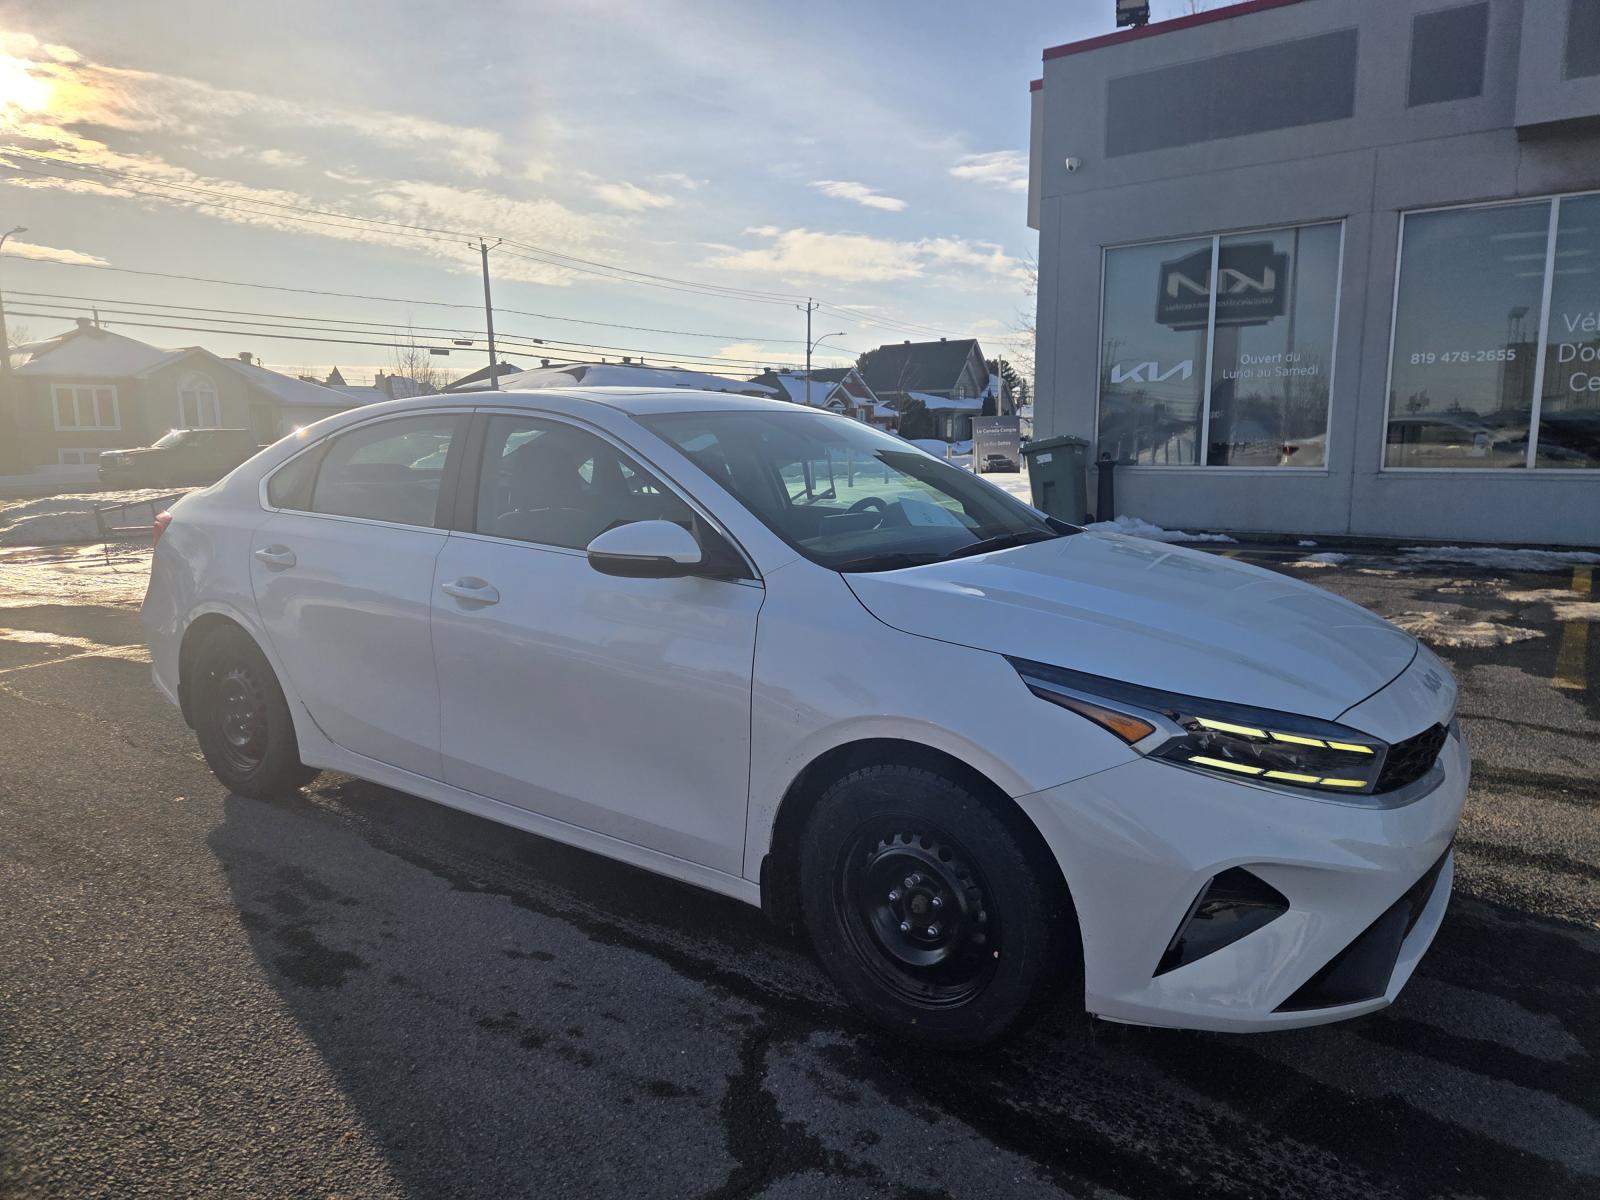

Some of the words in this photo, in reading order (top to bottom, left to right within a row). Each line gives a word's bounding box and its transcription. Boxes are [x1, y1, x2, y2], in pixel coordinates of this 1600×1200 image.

[1240, 352, 1282, 365] Ouvert
[1285, 351, 1301, 362] du
[1410, 352, 1436, 365] 819
[1440, 349, 1517, 363] 478-2655
[1558, 342, 1600, 363] D'o
[1111, 360, 1193, 384] KIA
[1222, 367, 1254, 379] Lundi
[1256, 368, 1271, 378] au
[1274, 363, 1319, 377] Samedi
